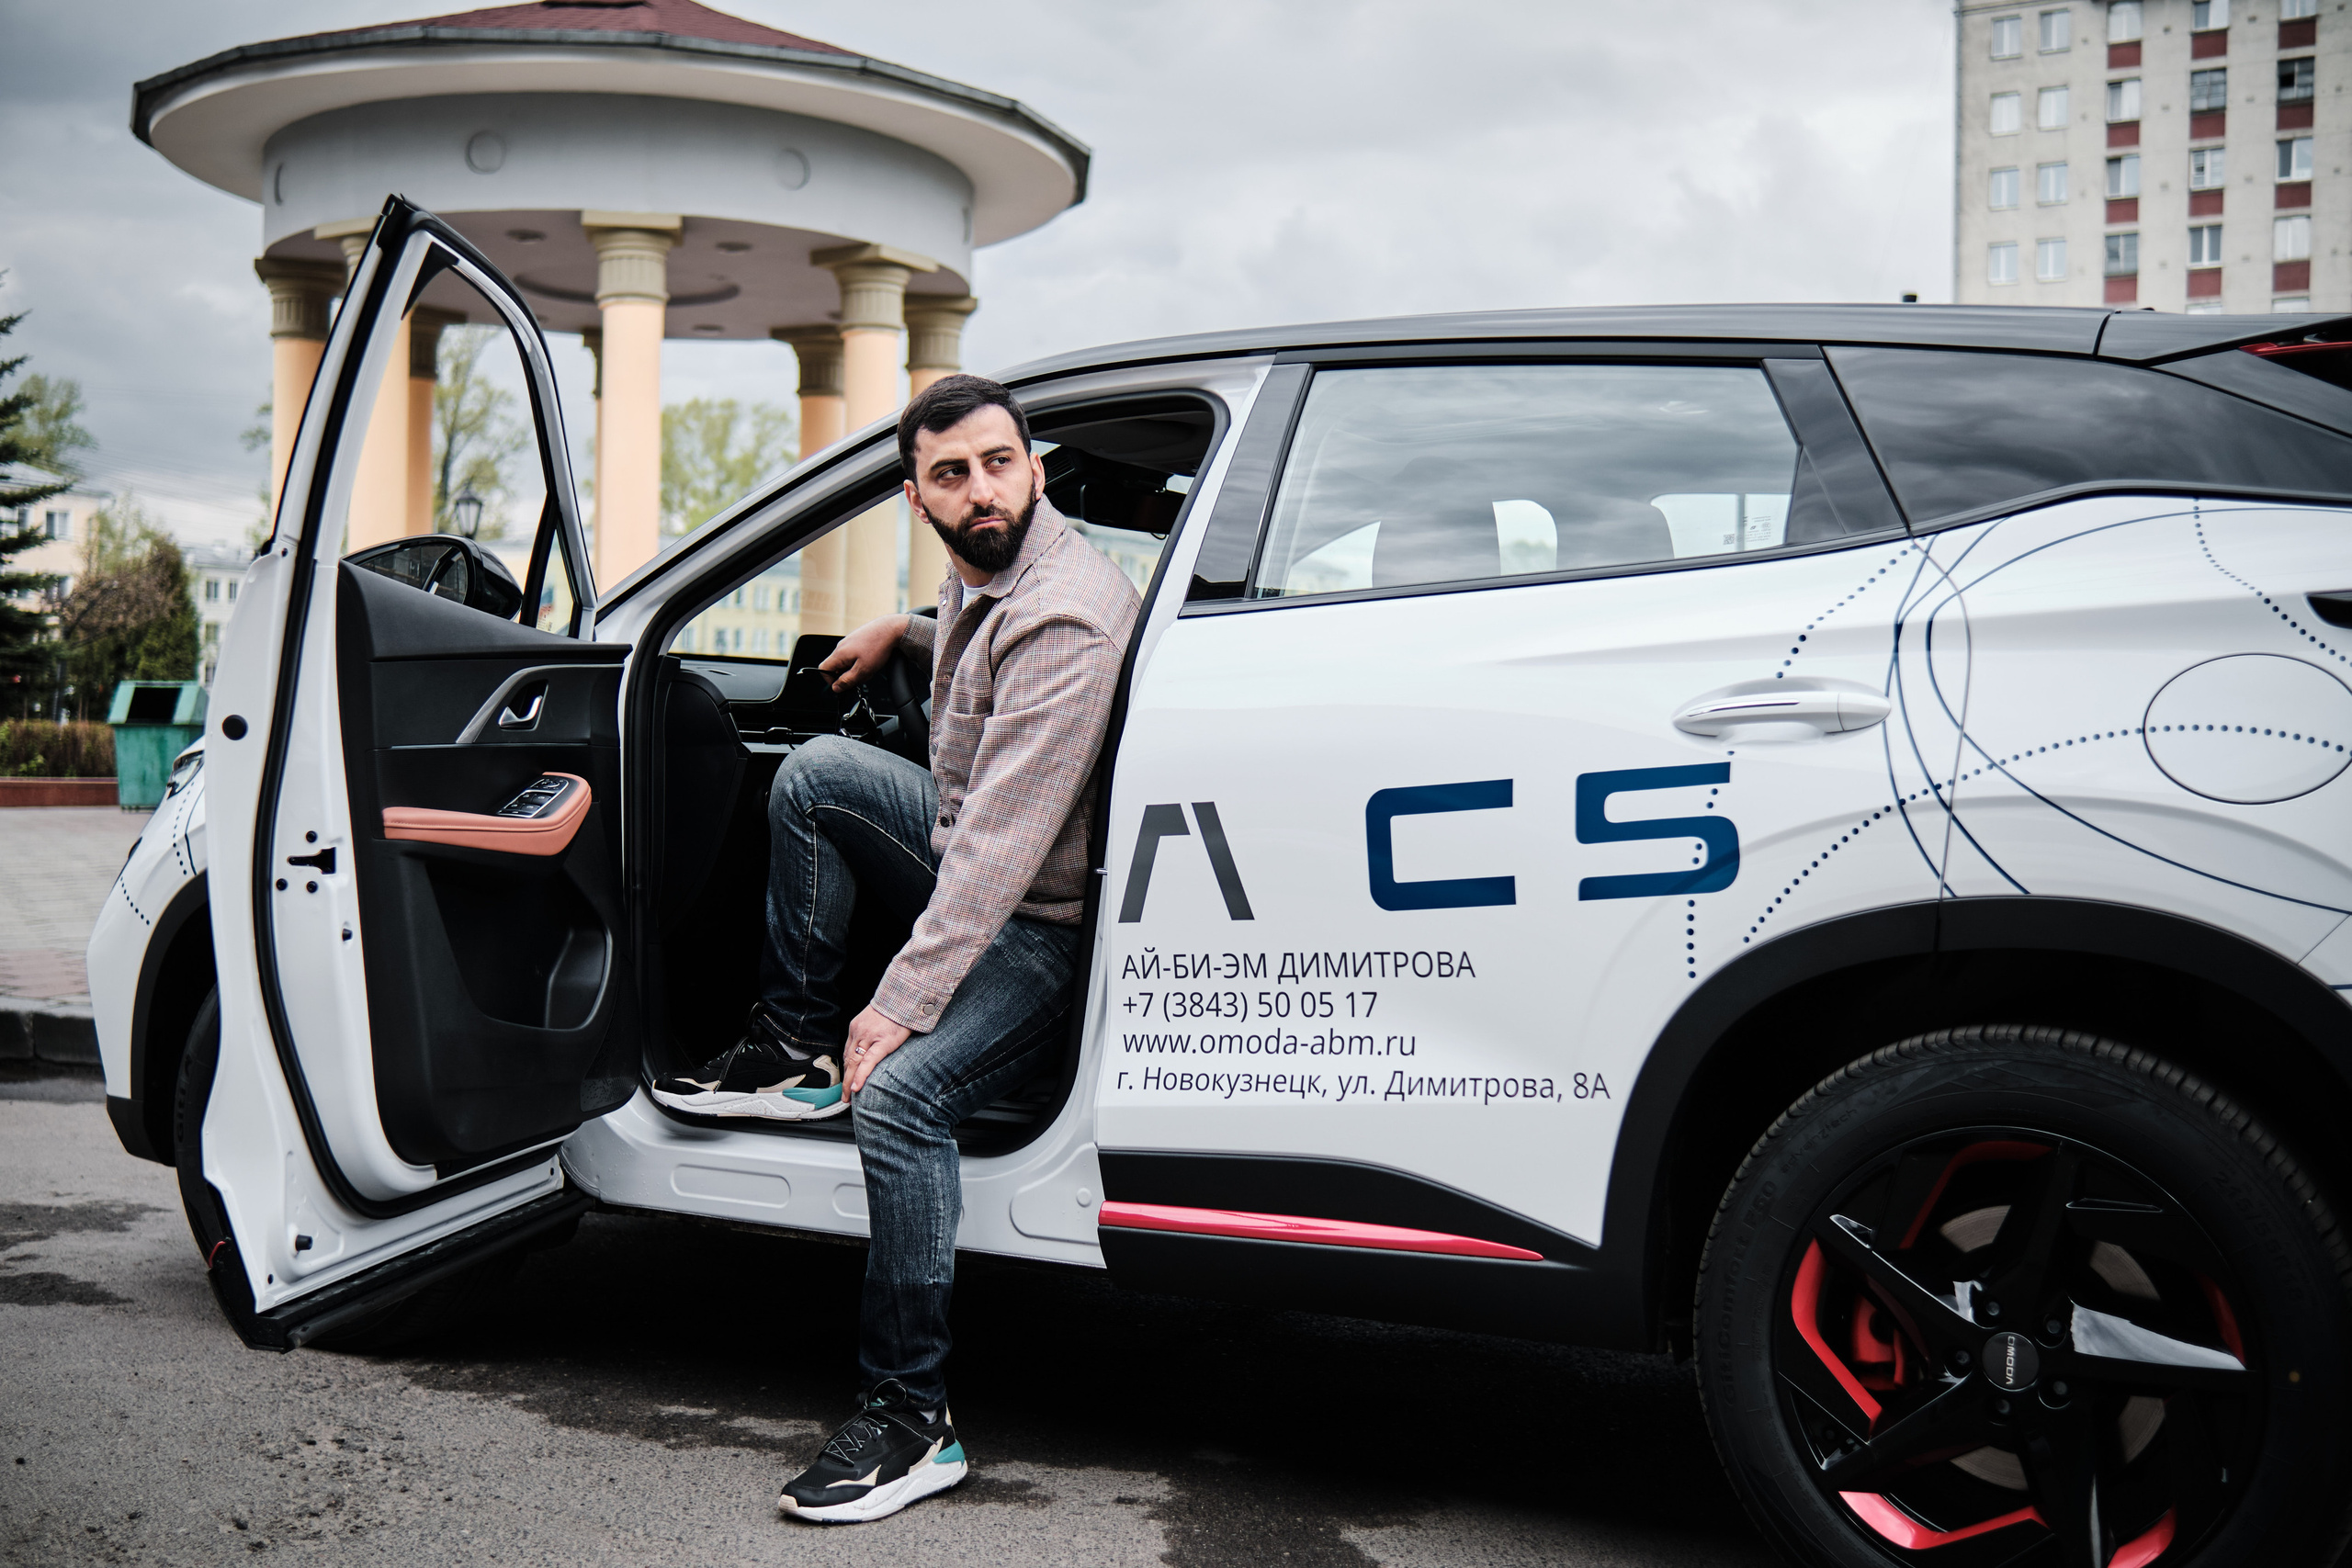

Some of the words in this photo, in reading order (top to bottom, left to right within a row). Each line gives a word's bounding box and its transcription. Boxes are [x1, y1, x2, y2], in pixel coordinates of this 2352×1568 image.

[1122, 947, 1268, 980] АЙ-БИ-ЭМ
[1278, 952, 1476, 984] ДИМИТРОВА
[1123, 992, 1154, 1018] +7
[1163, 992, 1249, 1022] (3843)
[1258, 992, 1291, 1018] 50
[1301, 992, 1334, 1018] 05
[1345, 992, 1378, 1018] 17
[1123, 1027, 1416, 1055] www.omoda-abm.ru
[1117, 1072, 1133, 1090] г.
[1143, 1067, 1327, 1100] Новокузнецк,
[1336, 1076, 1375, 1102] ул.
[1384, 1070, 1562, 1105] Димитрова,
[1574, 1072, 1611, 1100] 8А
[2006, 1336, 2016, 1385] OMODA
